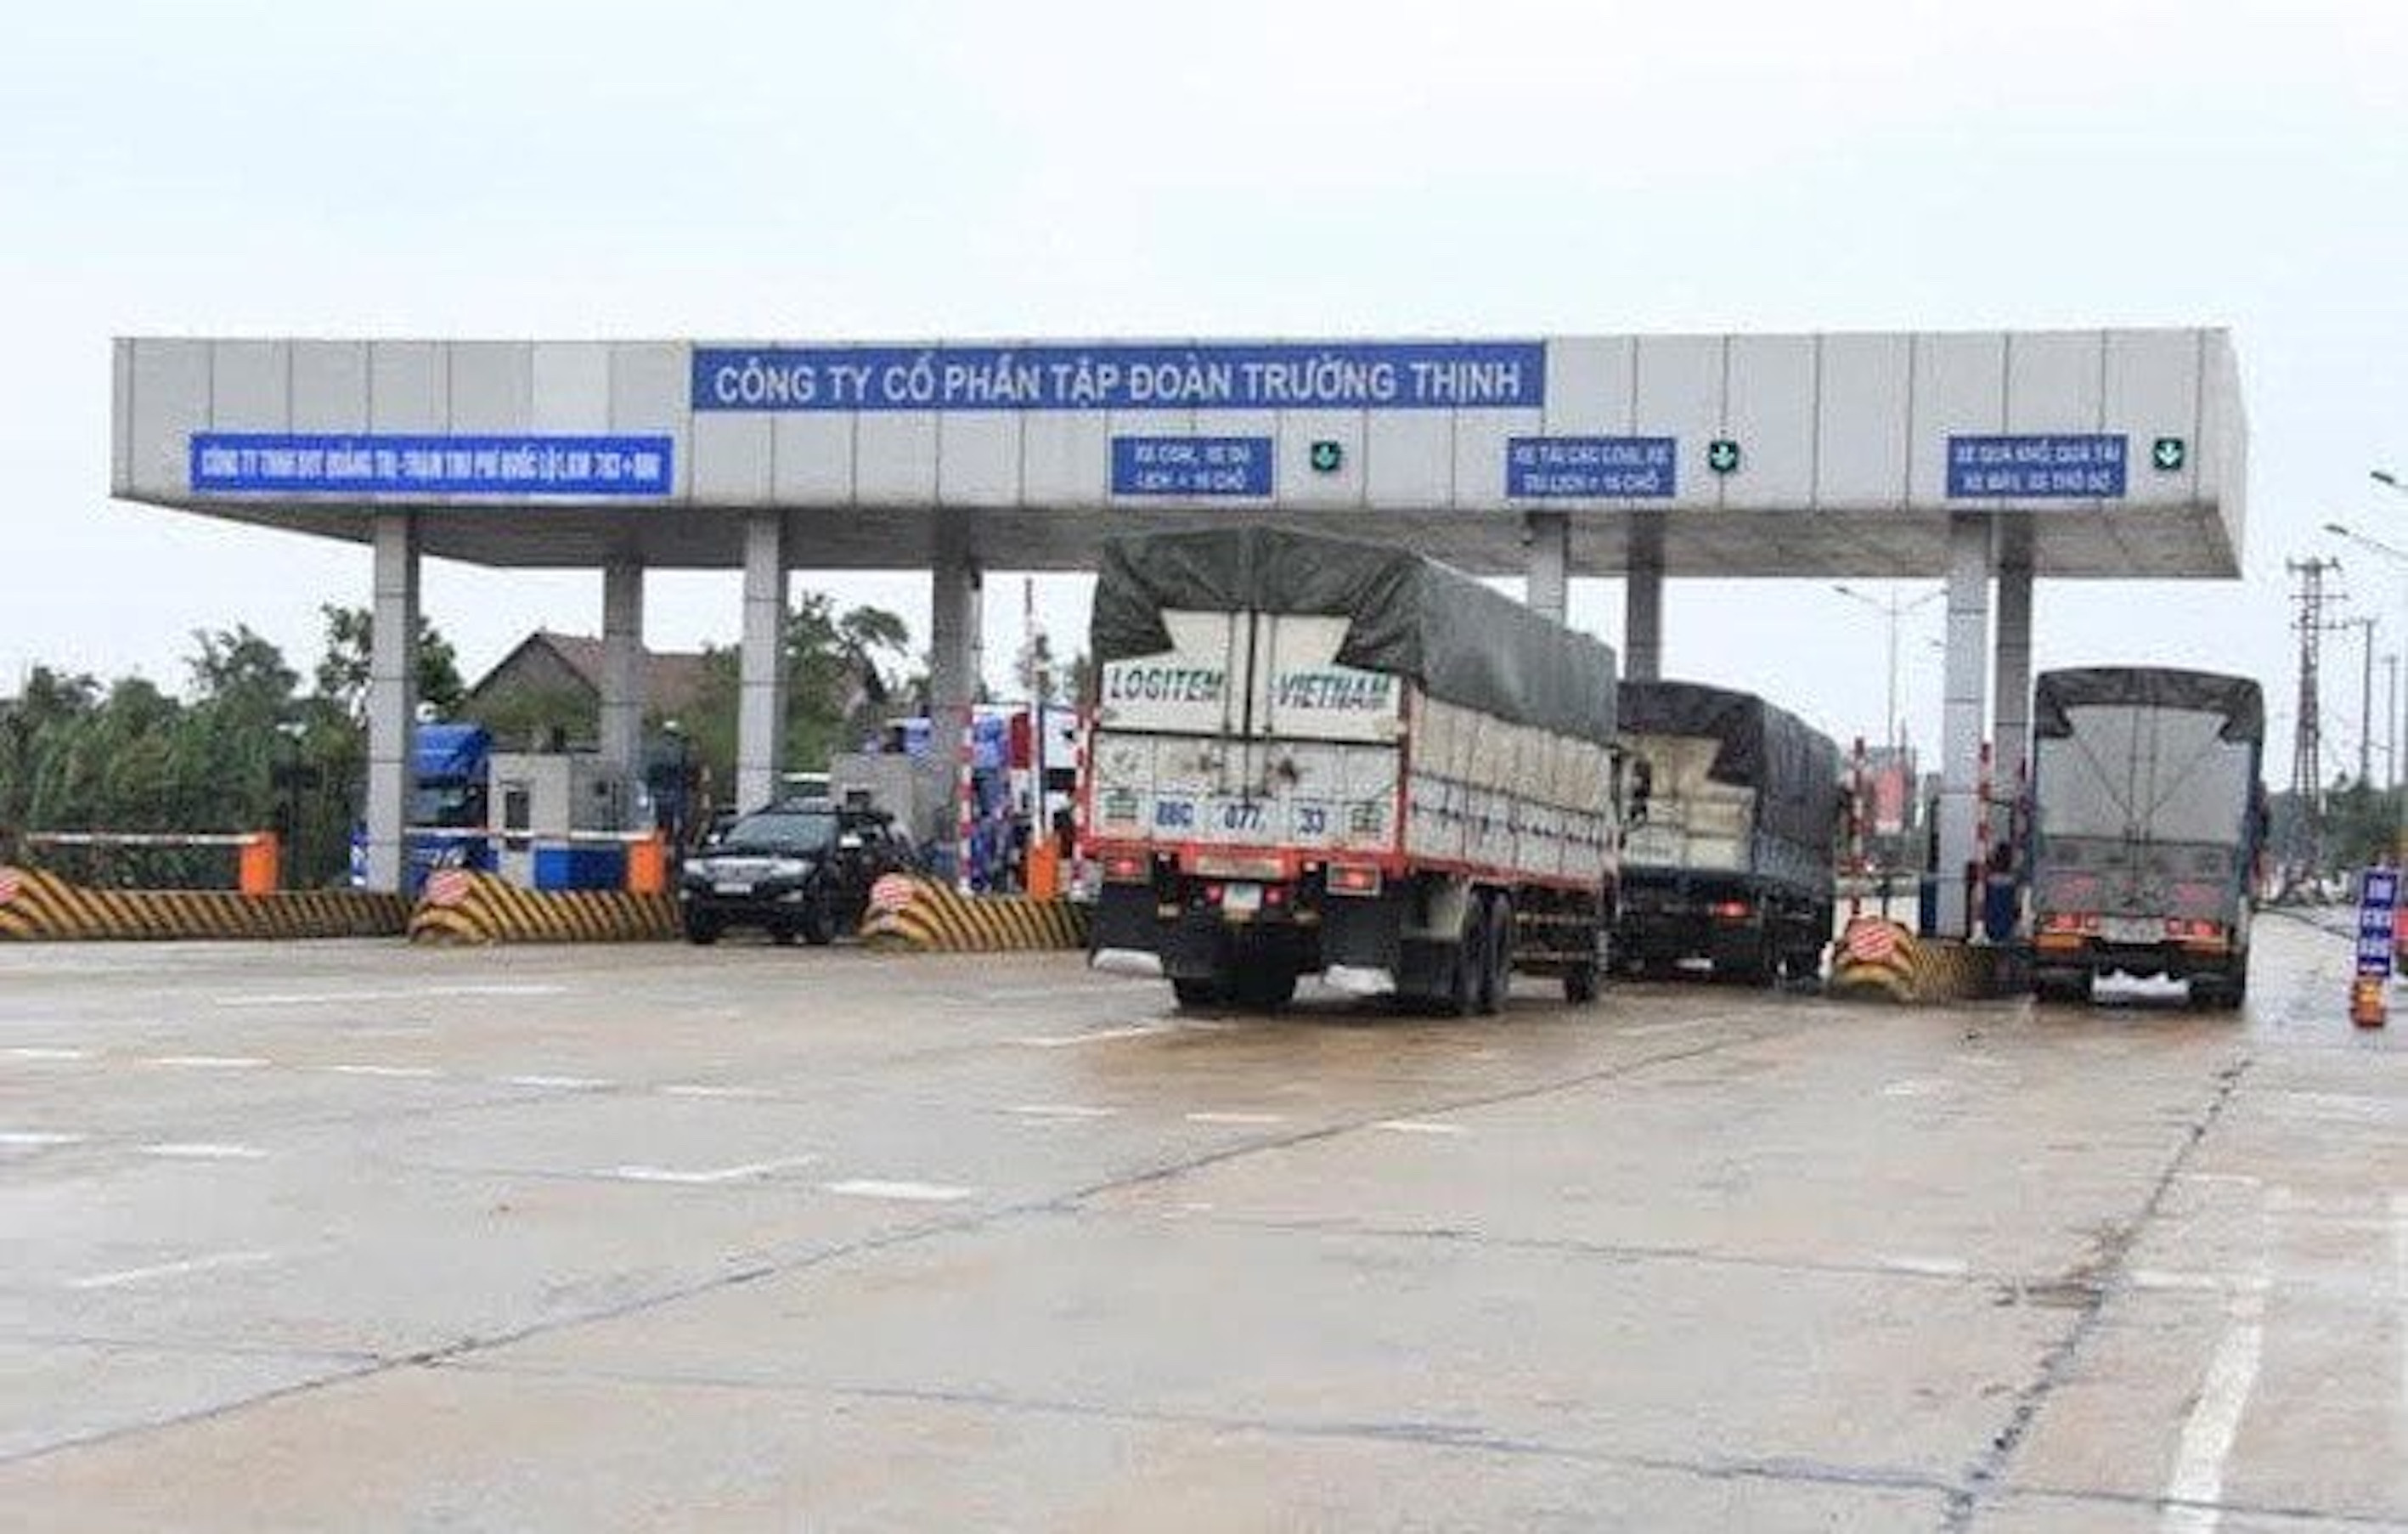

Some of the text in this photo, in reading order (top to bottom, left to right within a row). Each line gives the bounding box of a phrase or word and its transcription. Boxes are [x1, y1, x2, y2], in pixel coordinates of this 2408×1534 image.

[714, 357, 815, 403] CÔNG
[828, 365, 872, 402] TY
[1050, 357, 1120, 407] TẬP
[1129, 352, 1233, 401] ĐOÀN
[1243, 352, 1397, 401] TRƯỜNG
[1409, 361, 1522, 404] THỊNH
[1110, 667, 1391, 712] LOGITEM VIETNAM
